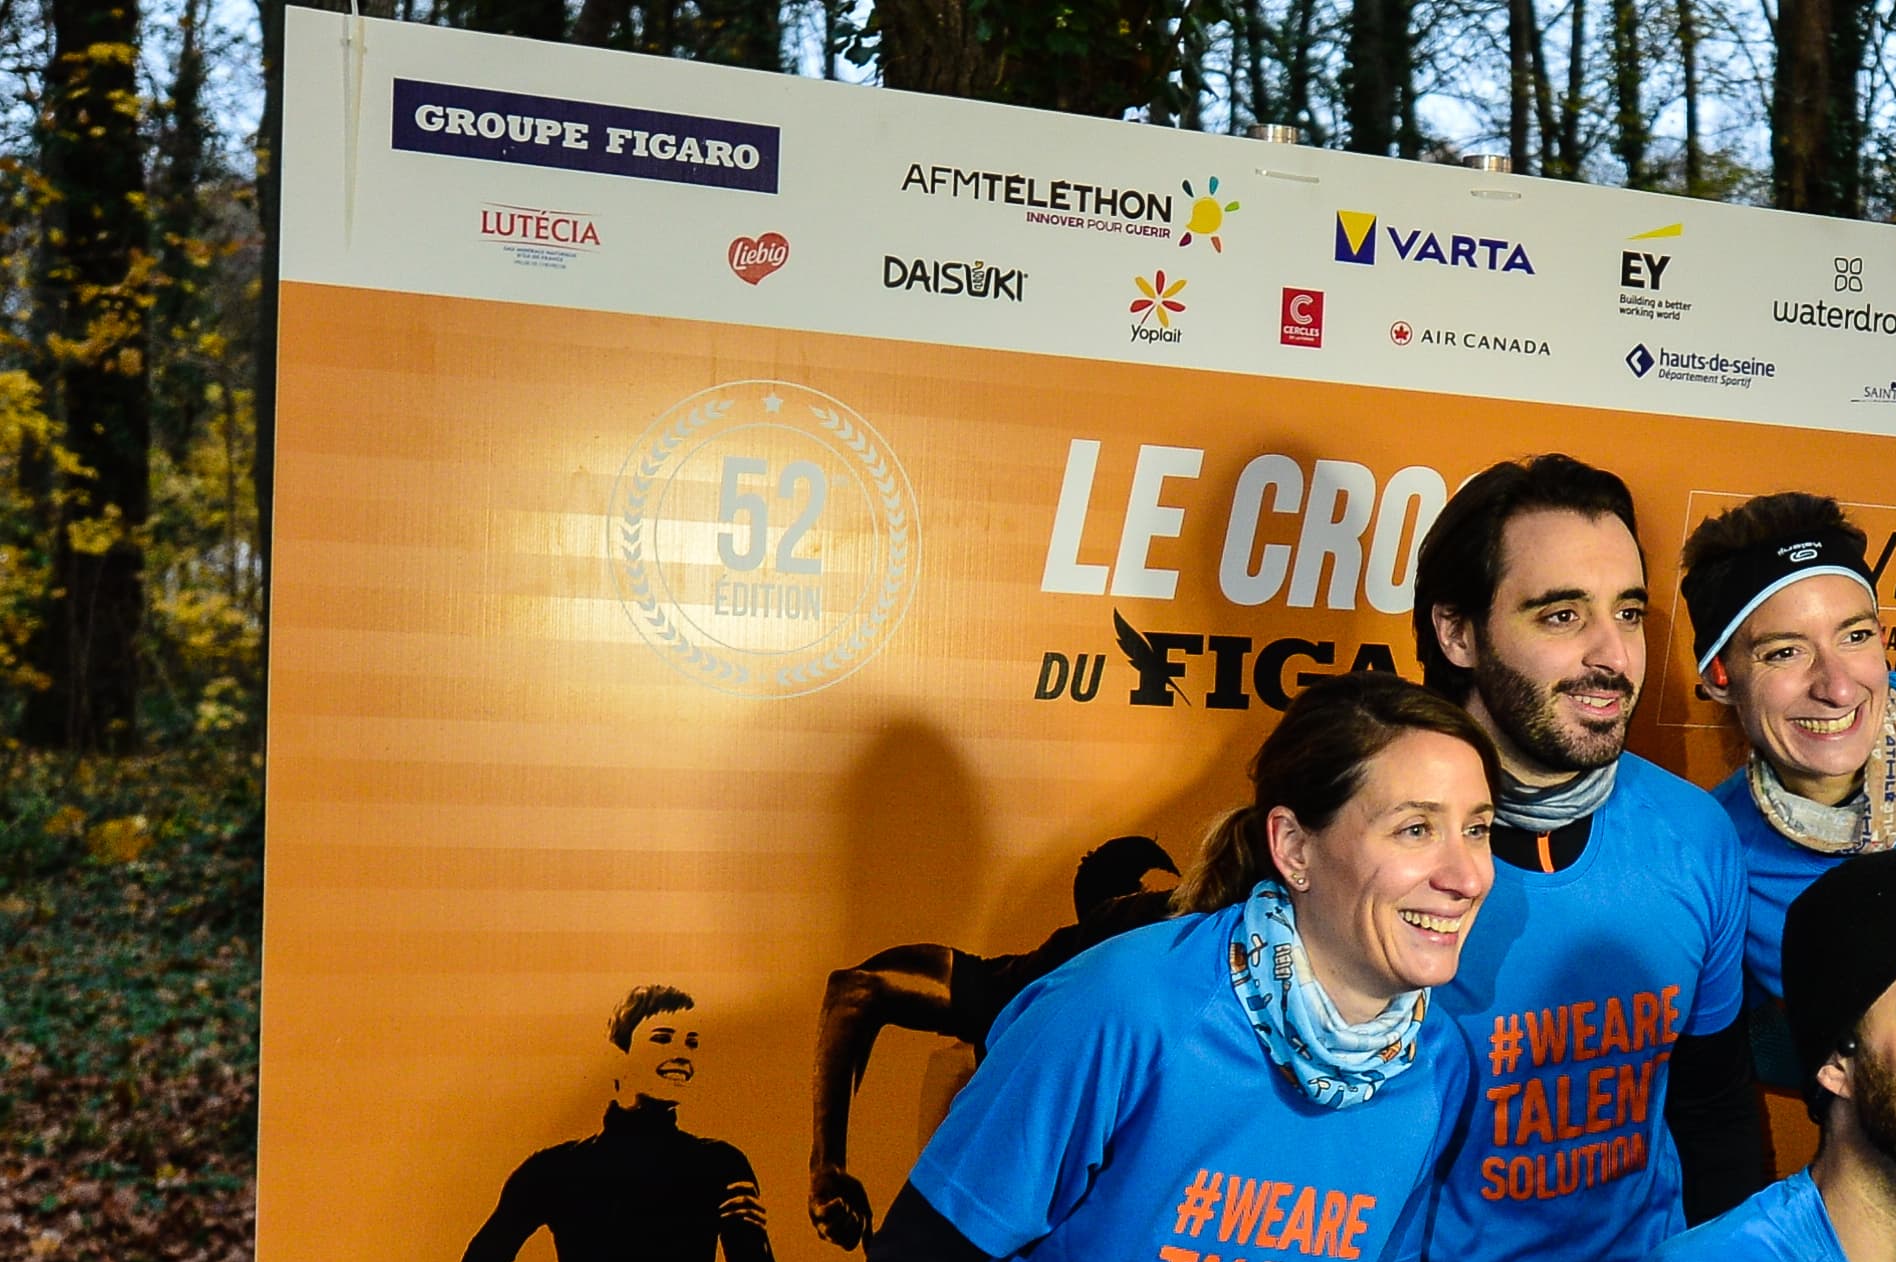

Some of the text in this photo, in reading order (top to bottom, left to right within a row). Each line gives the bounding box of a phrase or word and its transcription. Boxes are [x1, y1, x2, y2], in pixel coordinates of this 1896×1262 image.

[415, 104, 760, 170] GROUPE FIGARO
[481, 210, 601, 246] LUTÉCIA
[1026, 211, 1084, 228] INNOVER
[1087, 219, 1122, 233] POUR
[733, 241, 787, 270] Liebig
[1387, 226, 1535, 275] VARTA
[1620, 250, 1671, 290] EY
[883, 255, 1023, 301] DAISUKI
[1619, 294, 1656, 309] Building
[1665, 299, 1692, 311] better
[1619, 307, 1681, 320] working world
[1130, 323, 1183, 344] Yoplait
[1421, 329, 1551, 356] AIR CANADA
[1658, 368, 1752, 388] Département Sportif
[1659, 348, 1775, 377] hauts-de-seine
[717, 455, 827, 576] 52
[1040, 438, 1450, 615] LE CRO
[714, 575, 821, 622] ÉDITION
[1034, 622, 1408, 712] DU FIGA
[1489, 984, 1681, 1077] #WEARE
[1175, 1168, 1377, 1260] #WEARE
